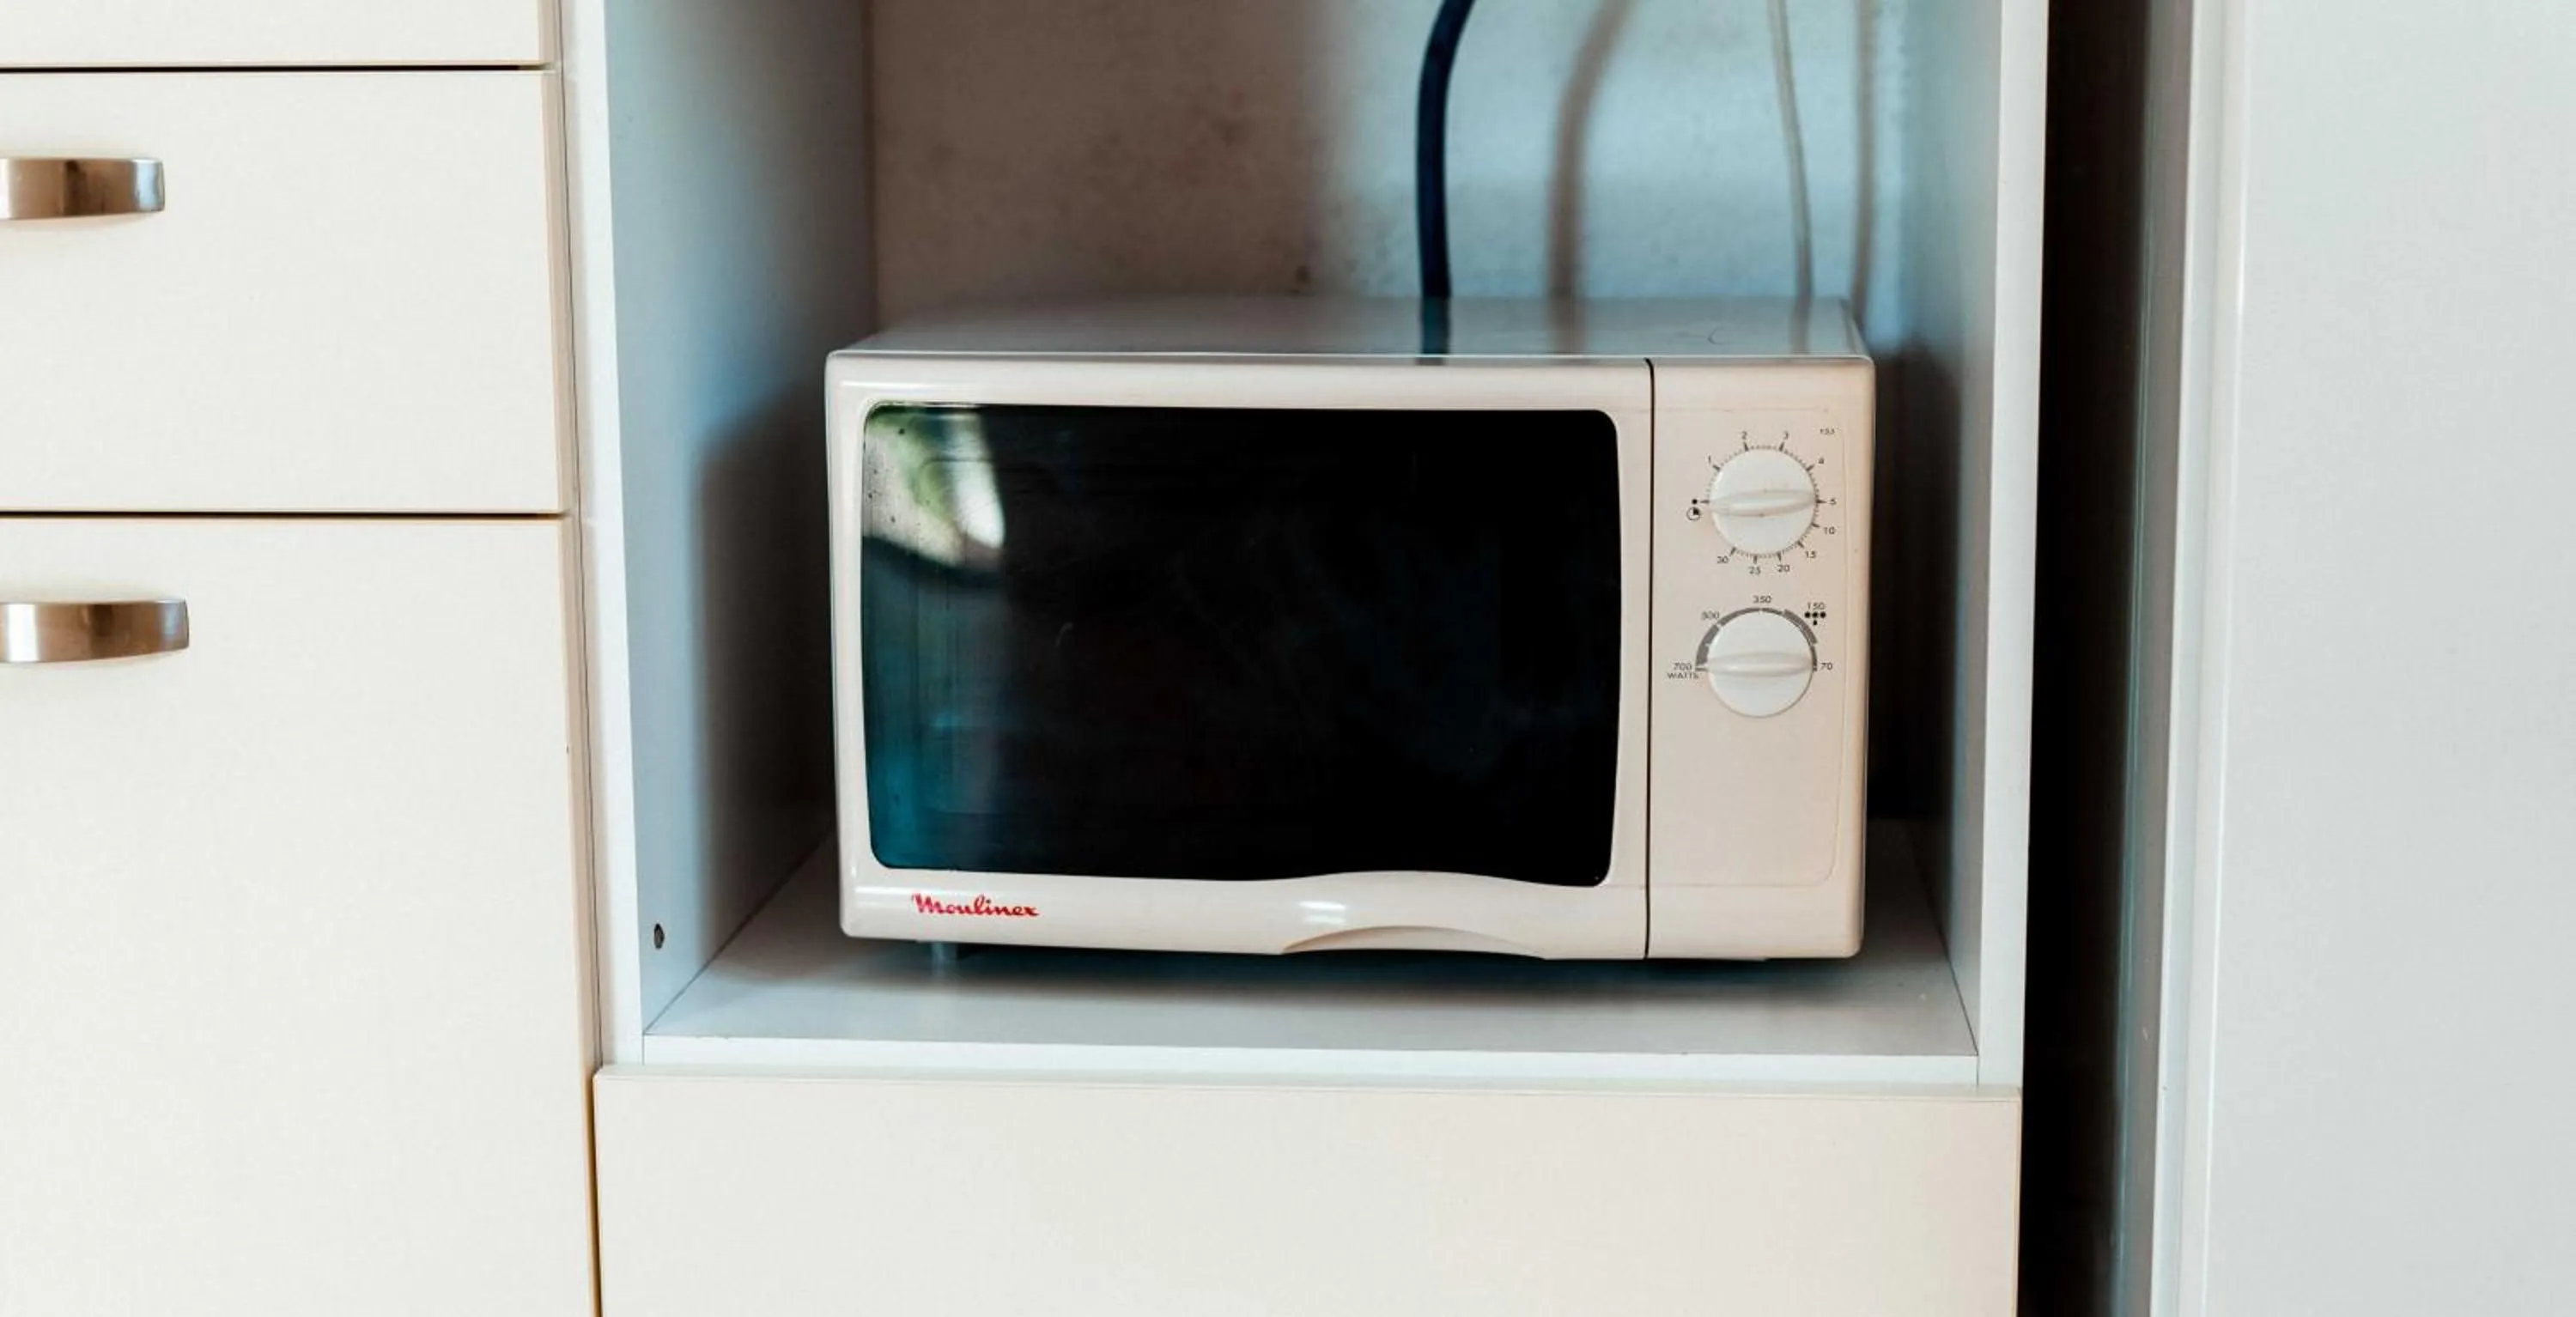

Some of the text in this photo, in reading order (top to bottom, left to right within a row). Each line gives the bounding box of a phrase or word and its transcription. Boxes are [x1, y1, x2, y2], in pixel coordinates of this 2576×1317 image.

[1741, 431, 1748, 440] 2
[1783, 431, 1790, 440] 3
[1829, 498, 1838, 507] 5
[1823, 526, 1836, 536] 10
[1805, 550, 1817, 559] 15
[1749, 567, 1761, 575] 25
[1777, 565, 1790, 574] 20
[1753, 595, 1772, 604] 350
[1807, 602, 1826, 610] 150
[1674, 662, 1692, 671] 700
[1820, 662, 1833, 671] 70
[1667, 671, 1700, 681] WATTS
[911, 893, 1041, 917] Moulinex
